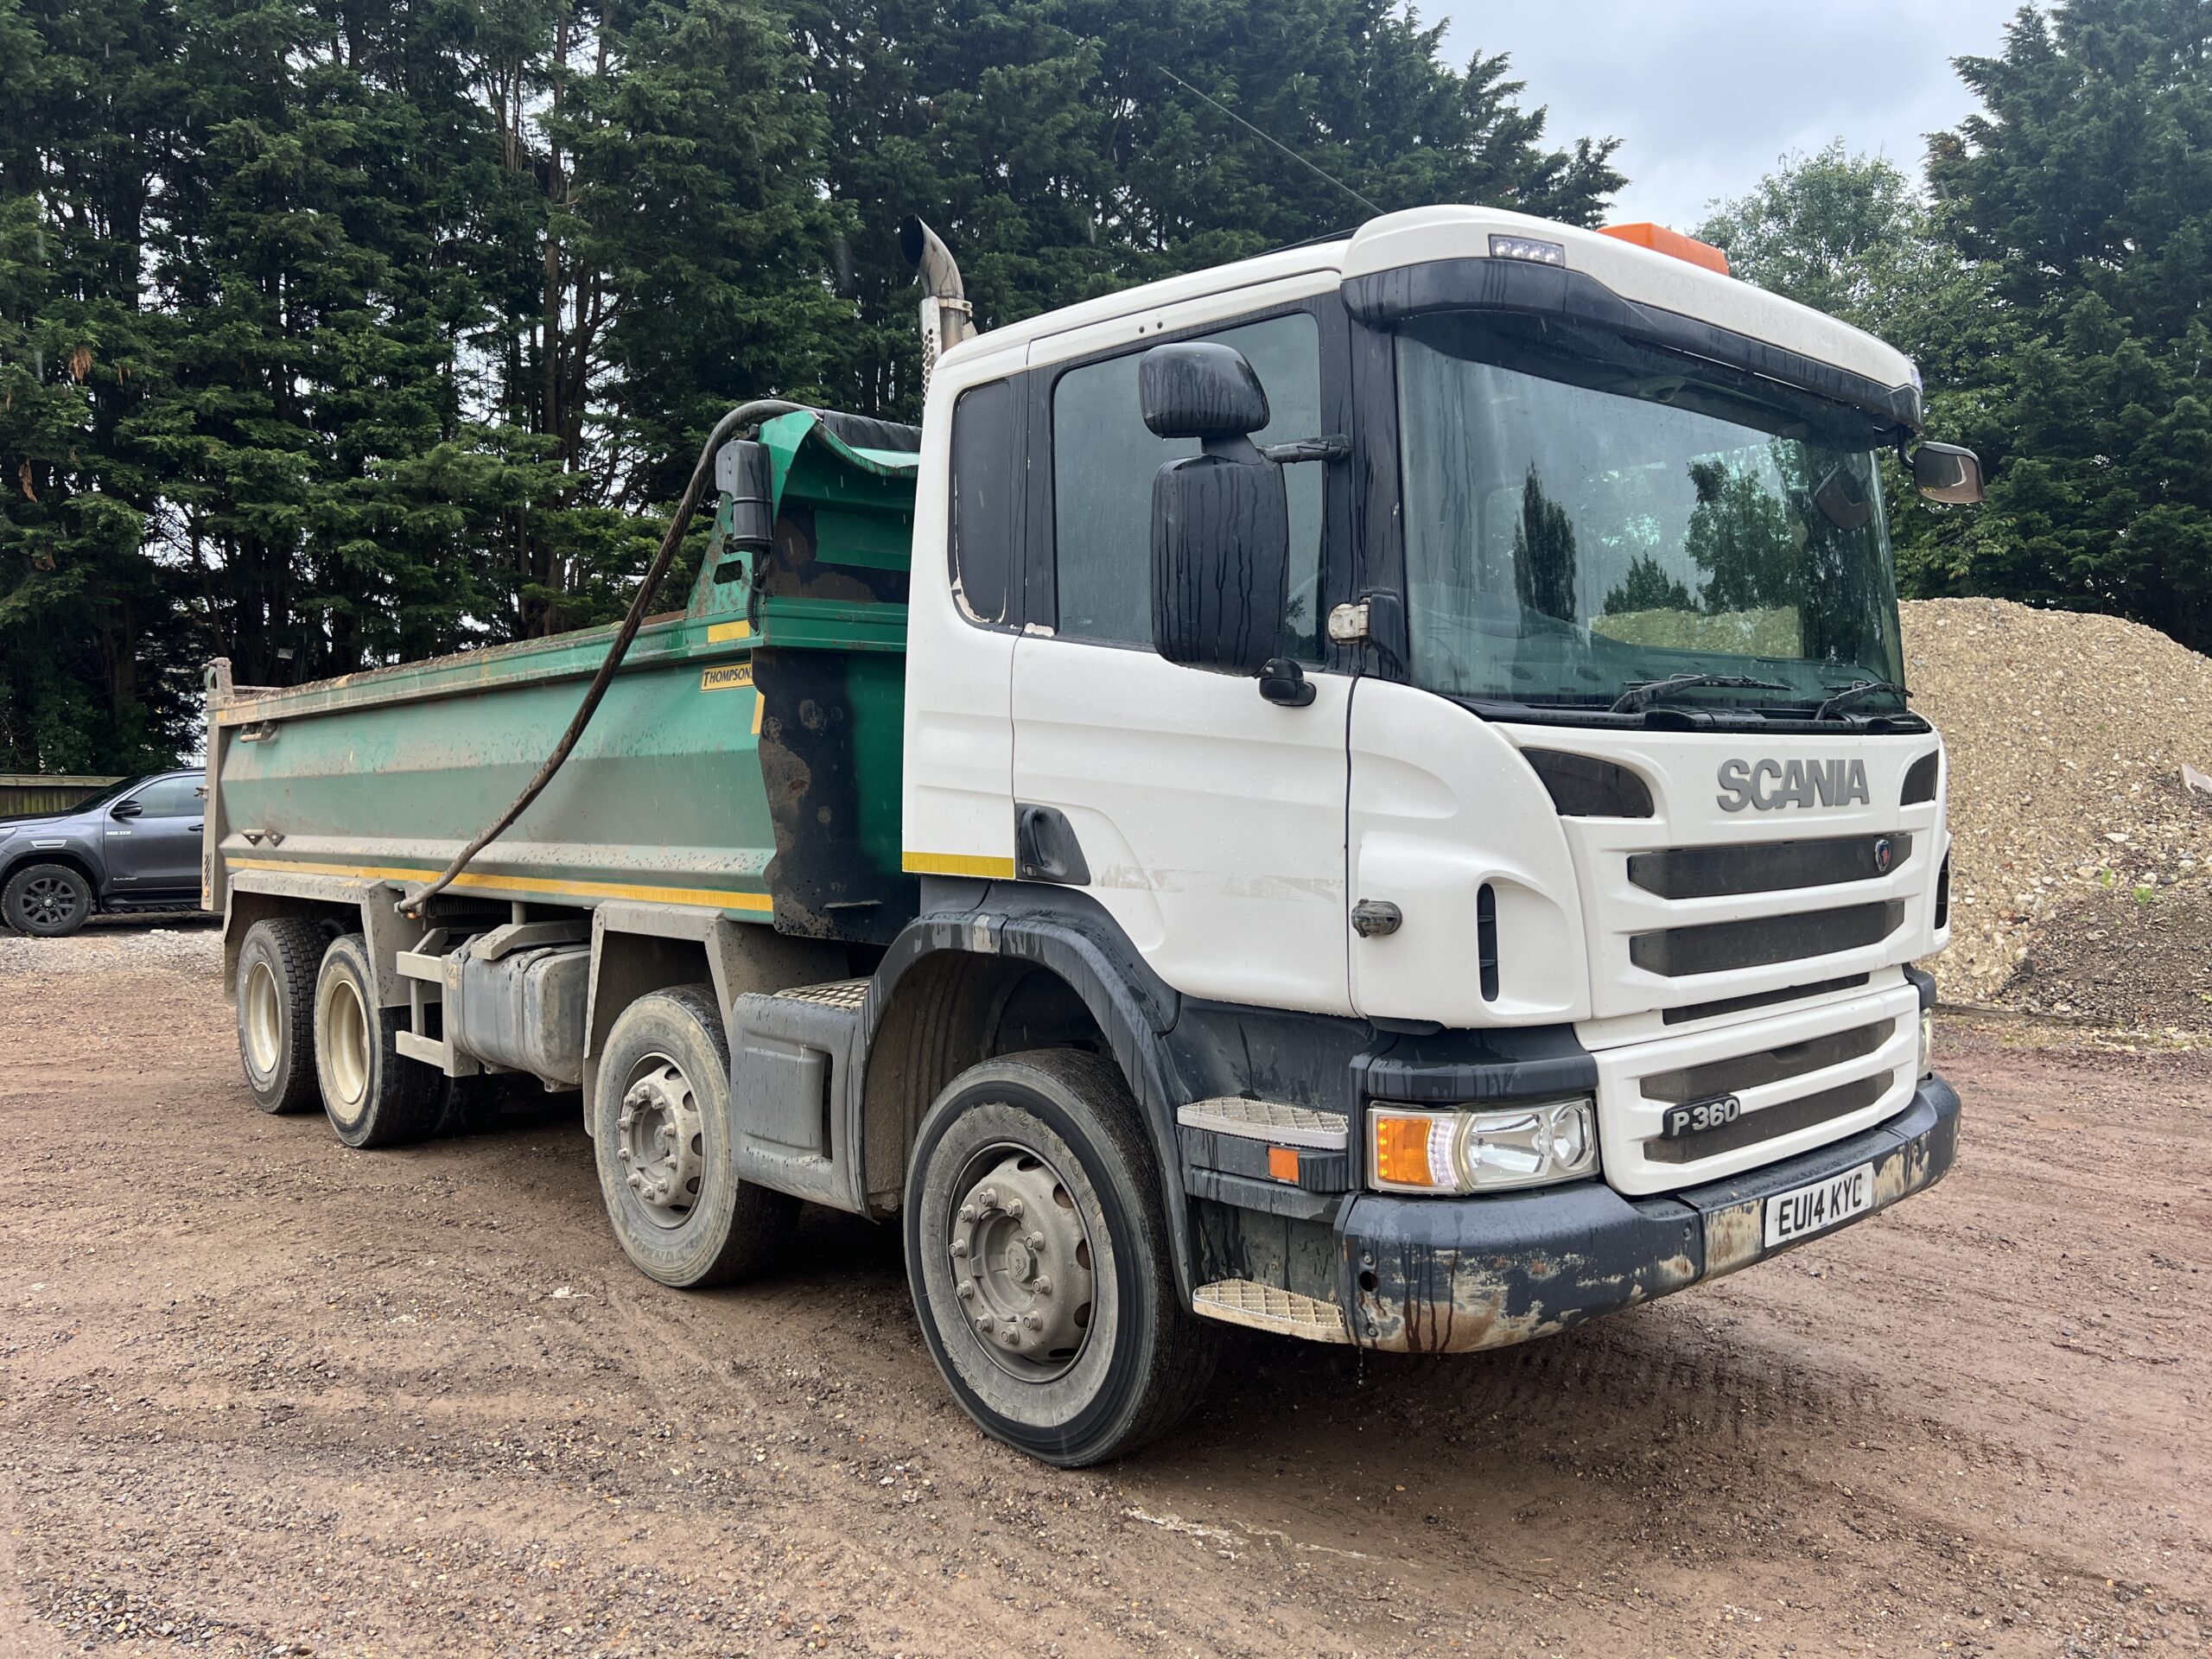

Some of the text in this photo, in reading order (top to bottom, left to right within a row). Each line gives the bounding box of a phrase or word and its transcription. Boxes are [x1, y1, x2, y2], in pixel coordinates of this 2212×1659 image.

[702, 667, 753, 687] THOMPSON
[1717, 759, 1870, 812] SCANIA
[1778, 1173, 1862, 1237] EU14 KYC
